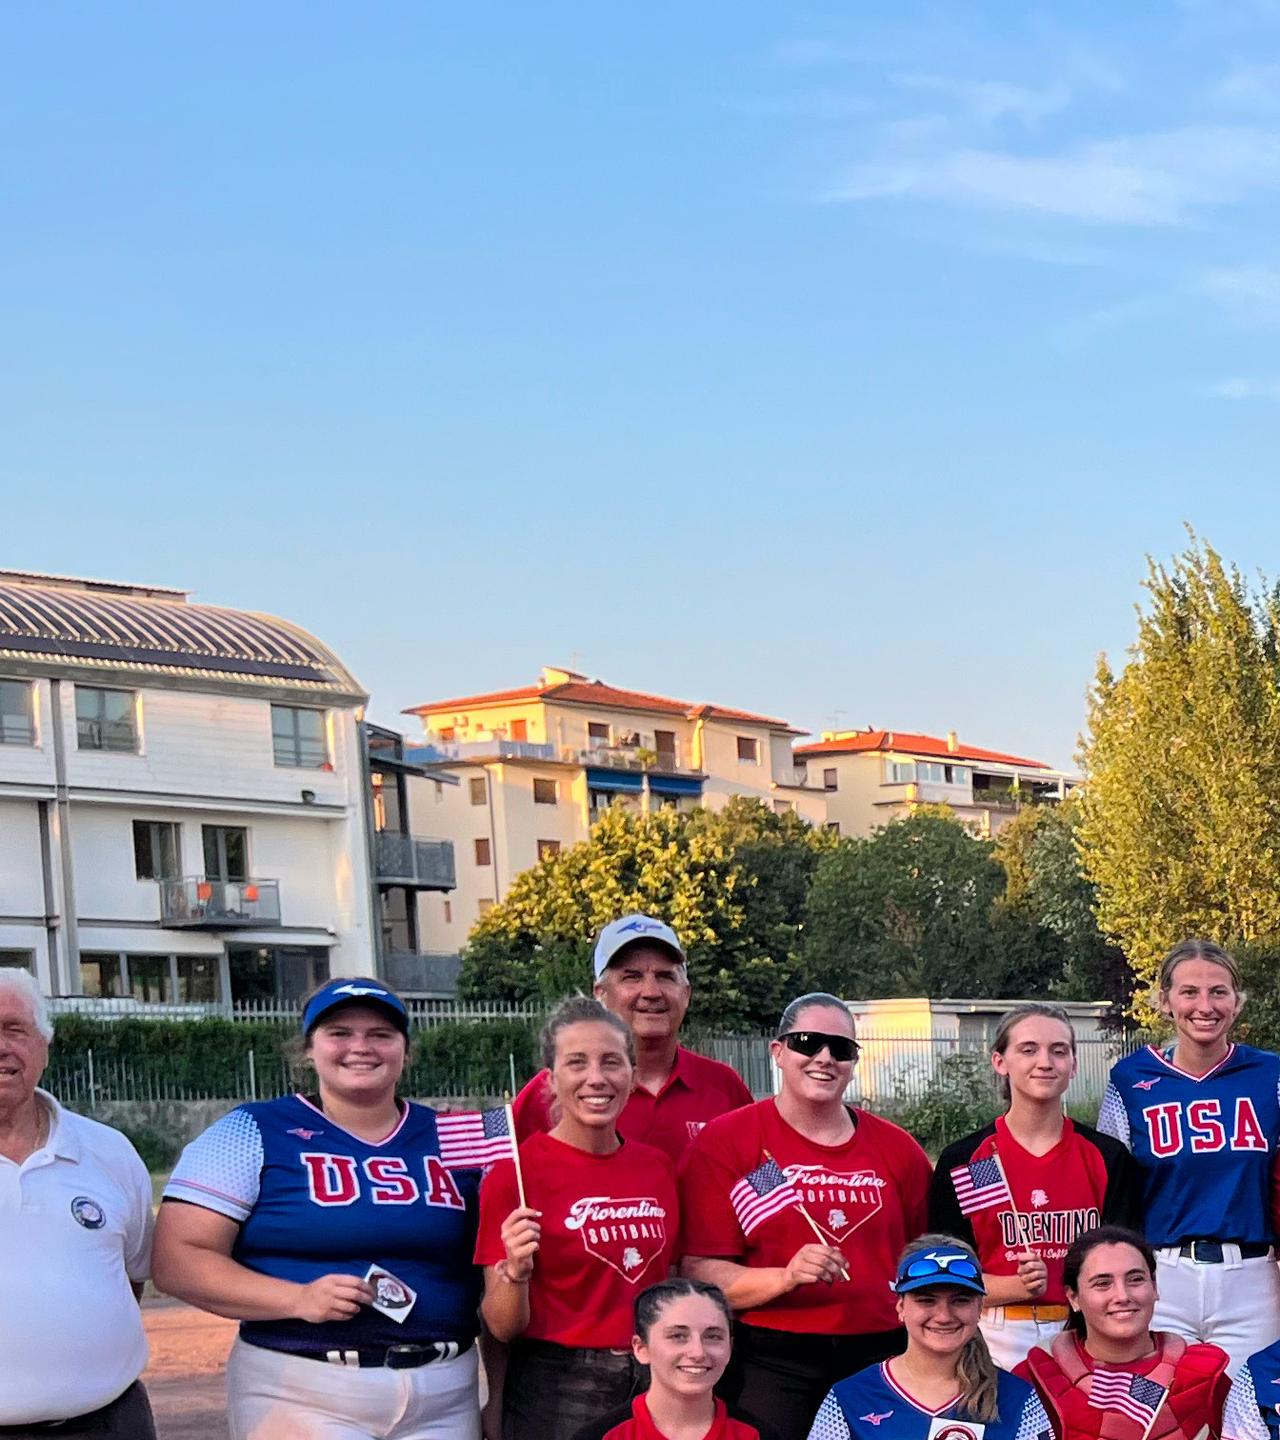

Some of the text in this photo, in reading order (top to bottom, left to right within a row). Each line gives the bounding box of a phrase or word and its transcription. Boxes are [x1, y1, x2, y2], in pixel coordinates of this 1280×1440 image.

[1143, 1097, 1269, 1158] USA
[300, 1152, 466, 1211] USA
[782, 1164, 887, 1188] Fiorentina
[796, 1189, 877, 1204] SOFTBALL
[564, 1197, 666, 1230] Fiorentina
[588, 1223, 663, 1245] SOFTBALL
